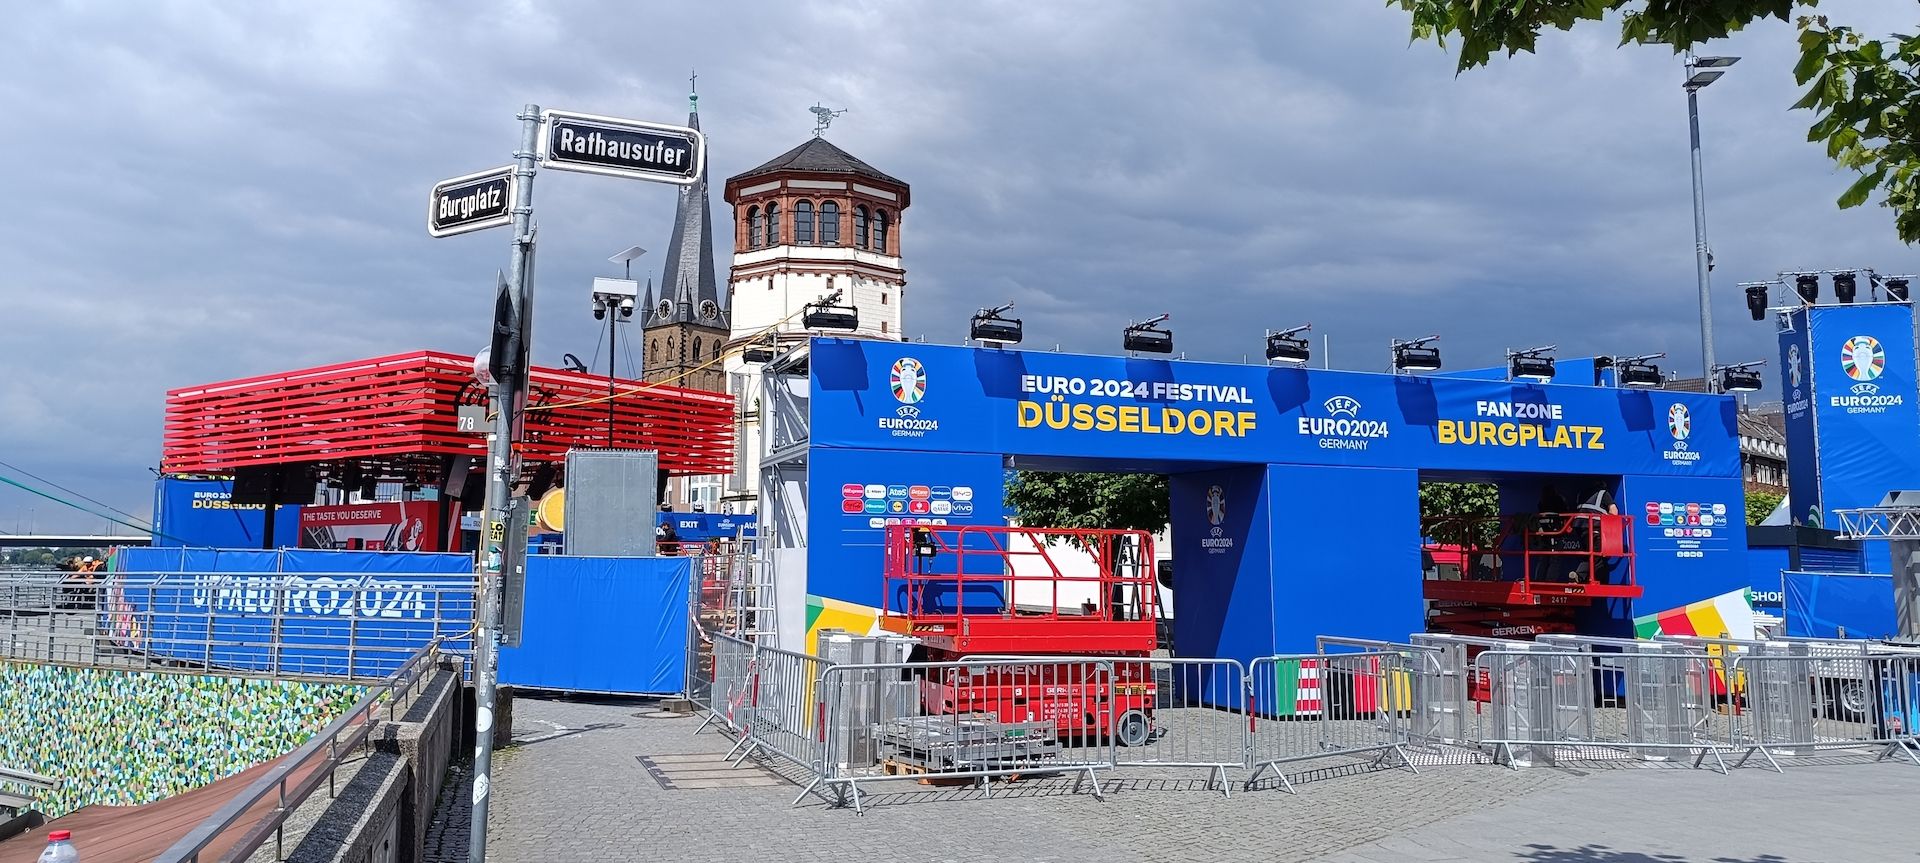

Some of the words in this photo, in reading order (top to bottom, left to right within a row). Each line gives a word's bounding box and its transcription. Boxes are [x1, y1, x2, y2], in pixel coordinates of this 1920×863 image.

[560, 127, 686, 166] Rathausufer
[439, 188, 501, 219] Burgplatz
[1021, 374, 1086, 395] EURO
[1090, 379, 1149, 399] 2024
[1153, 382, 1254, 404] FESTIVAL
[1851, 385, 1877, 395] UEFA
[1830, 395, 1903, 407] EURO2024
[897, 408, 919, 417] UEFA
[1326, 400, 1358, 415] UEFA
[1476, 400, 1512, 417] FAN
[1515, 402, 1563, 420] ZONE
[1847, 406, 1887, 414] GERMANY
[1017, 395, 1257, 437] DÜSSELDORF
[460, 416, 474, 430] 78
[878, 417, 939, 431] EURO2024
[1298, 416, 1389, 438] EURO2024
[1437, 419, 1605, 449] BURGPLATZ
[1318, 438, 1368, 450] GERMANY
[1663, 450, 1700, 460] EURO2024
[193, 491, 218, 499] EURO
[303, 512, 315, 521] THE
[316, 511, 336, 520] TASTE
[336, 510, 350, 520] YOU
[351, 509, 382, 519] DESERVE
[680, 520, 698, 529] EXIT
[1201, 538, 1233, 547] EURO2024
[1492, 625, 1535, 636] GERKEN
